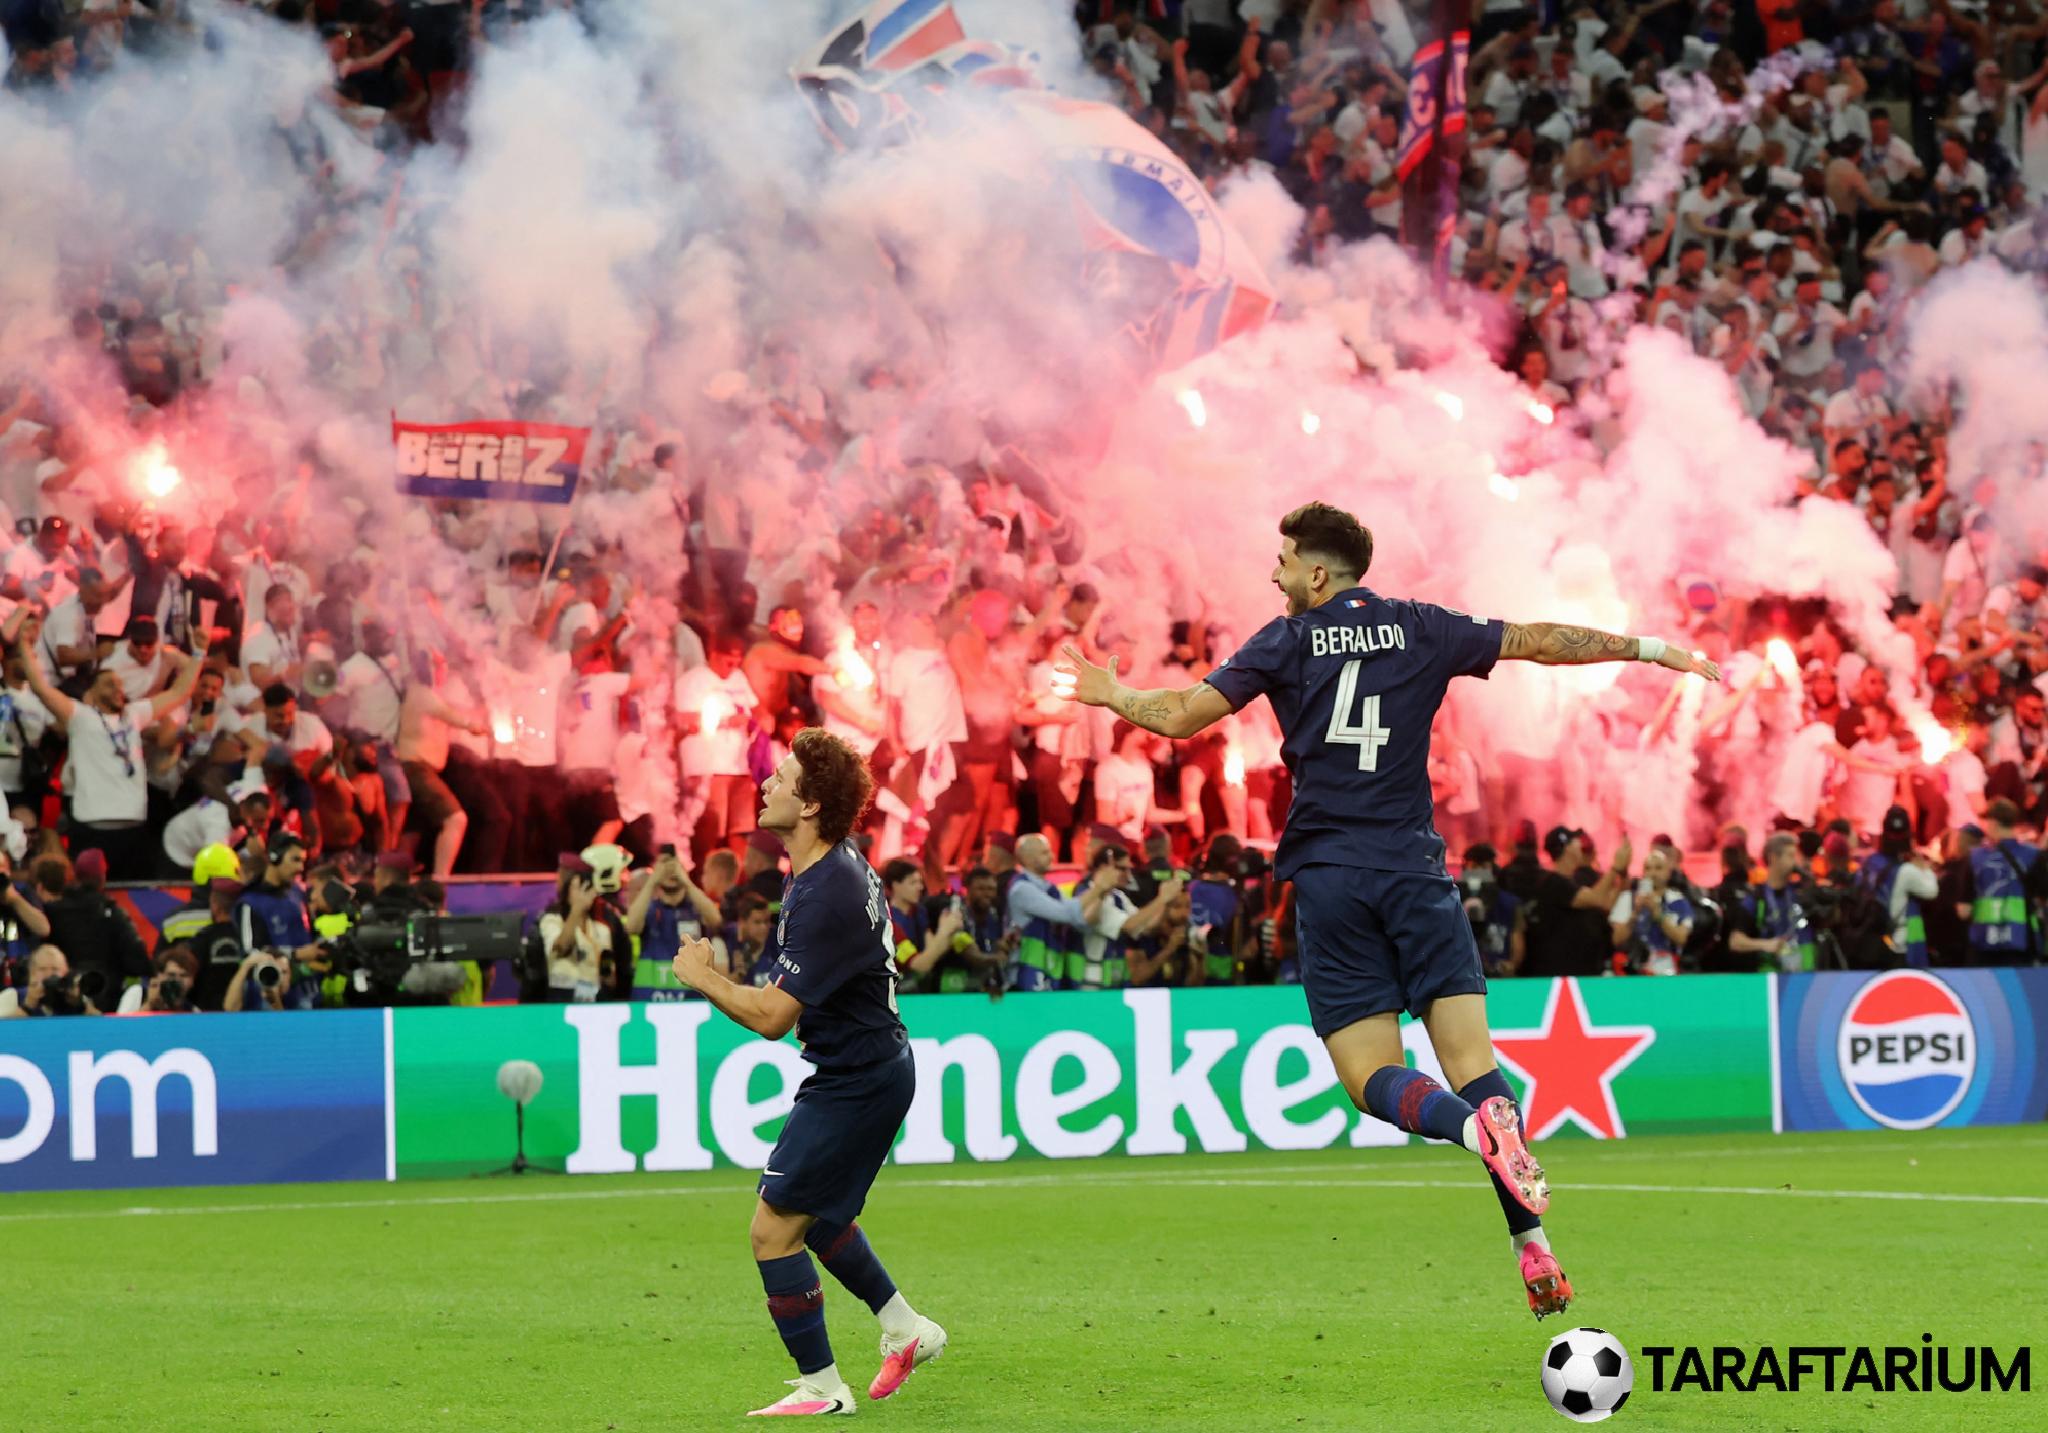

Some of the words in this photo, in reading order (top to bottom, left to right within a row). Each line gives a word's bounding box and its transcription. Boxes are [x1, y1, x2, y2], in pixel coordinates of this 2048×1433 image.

[1312, 623, 1406, 657] BERALDO
[1324, 659, 1391, 773] 4
[777, 953, 801, 975] OND
[1850, 1033, 1965, 1064] PEPSI
[564, 988, 1457, 1174] Heneke
